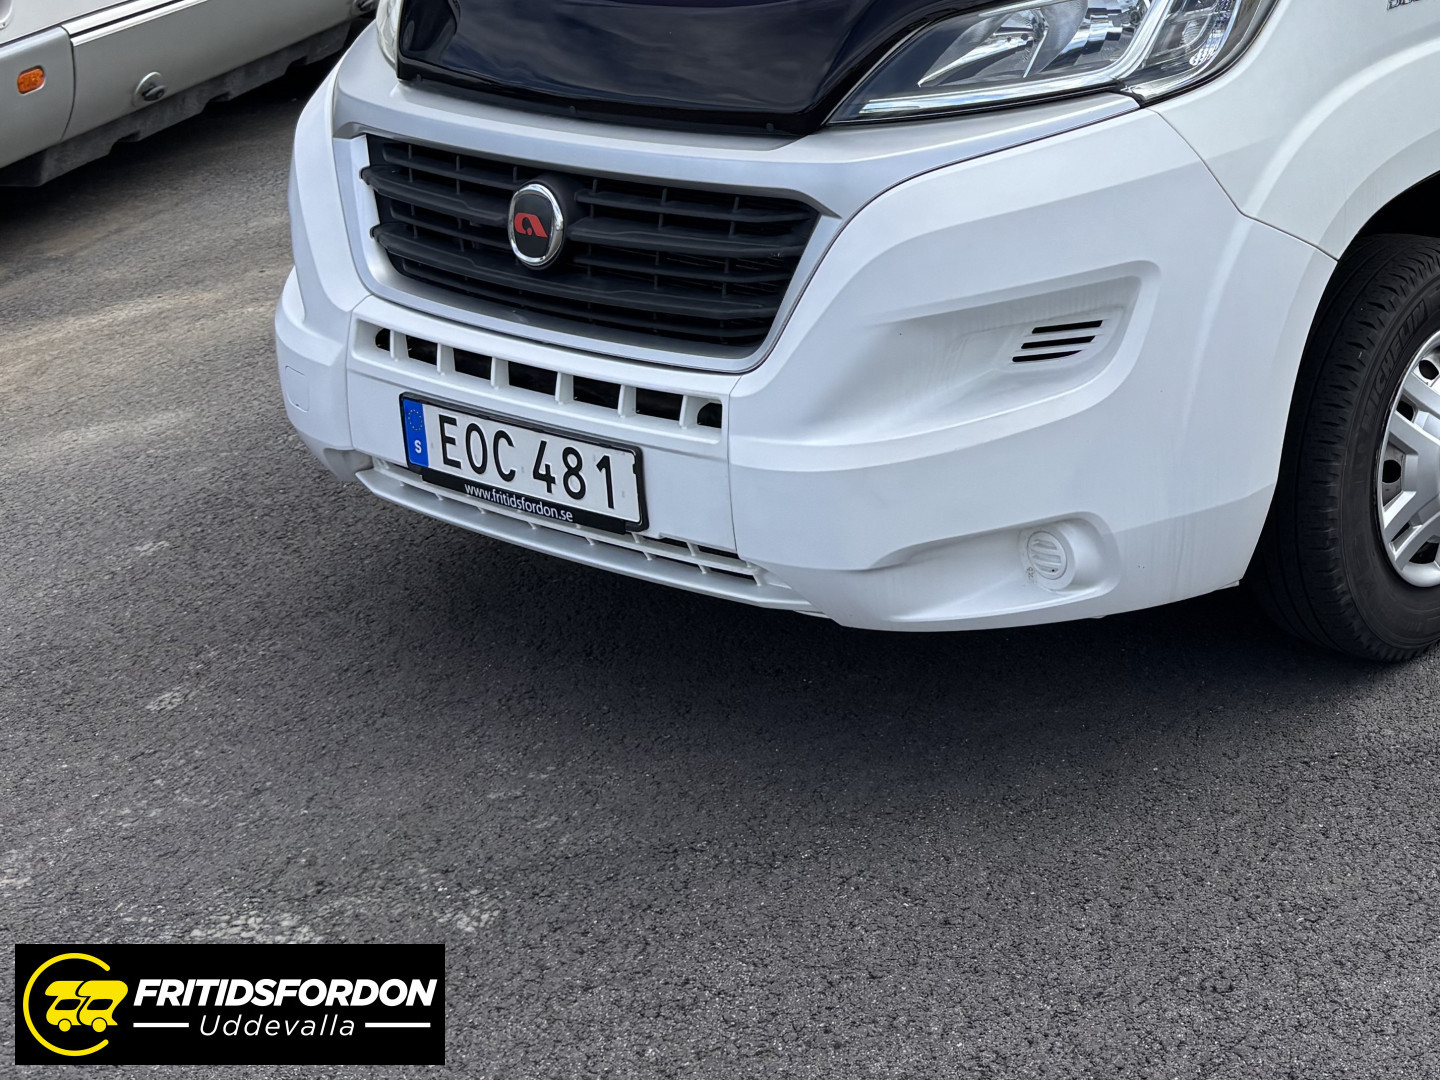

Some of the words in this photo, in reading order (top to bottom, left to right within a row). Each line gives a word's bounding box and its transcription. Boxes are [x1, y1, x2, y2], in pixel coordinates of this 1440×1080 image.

[414, 439, 422, 454] S
[438, 413, 517, 482] EOC
[532, 439, 616, 510] 481
[464, 482, 574, 522] www.fritidsfordon.se
